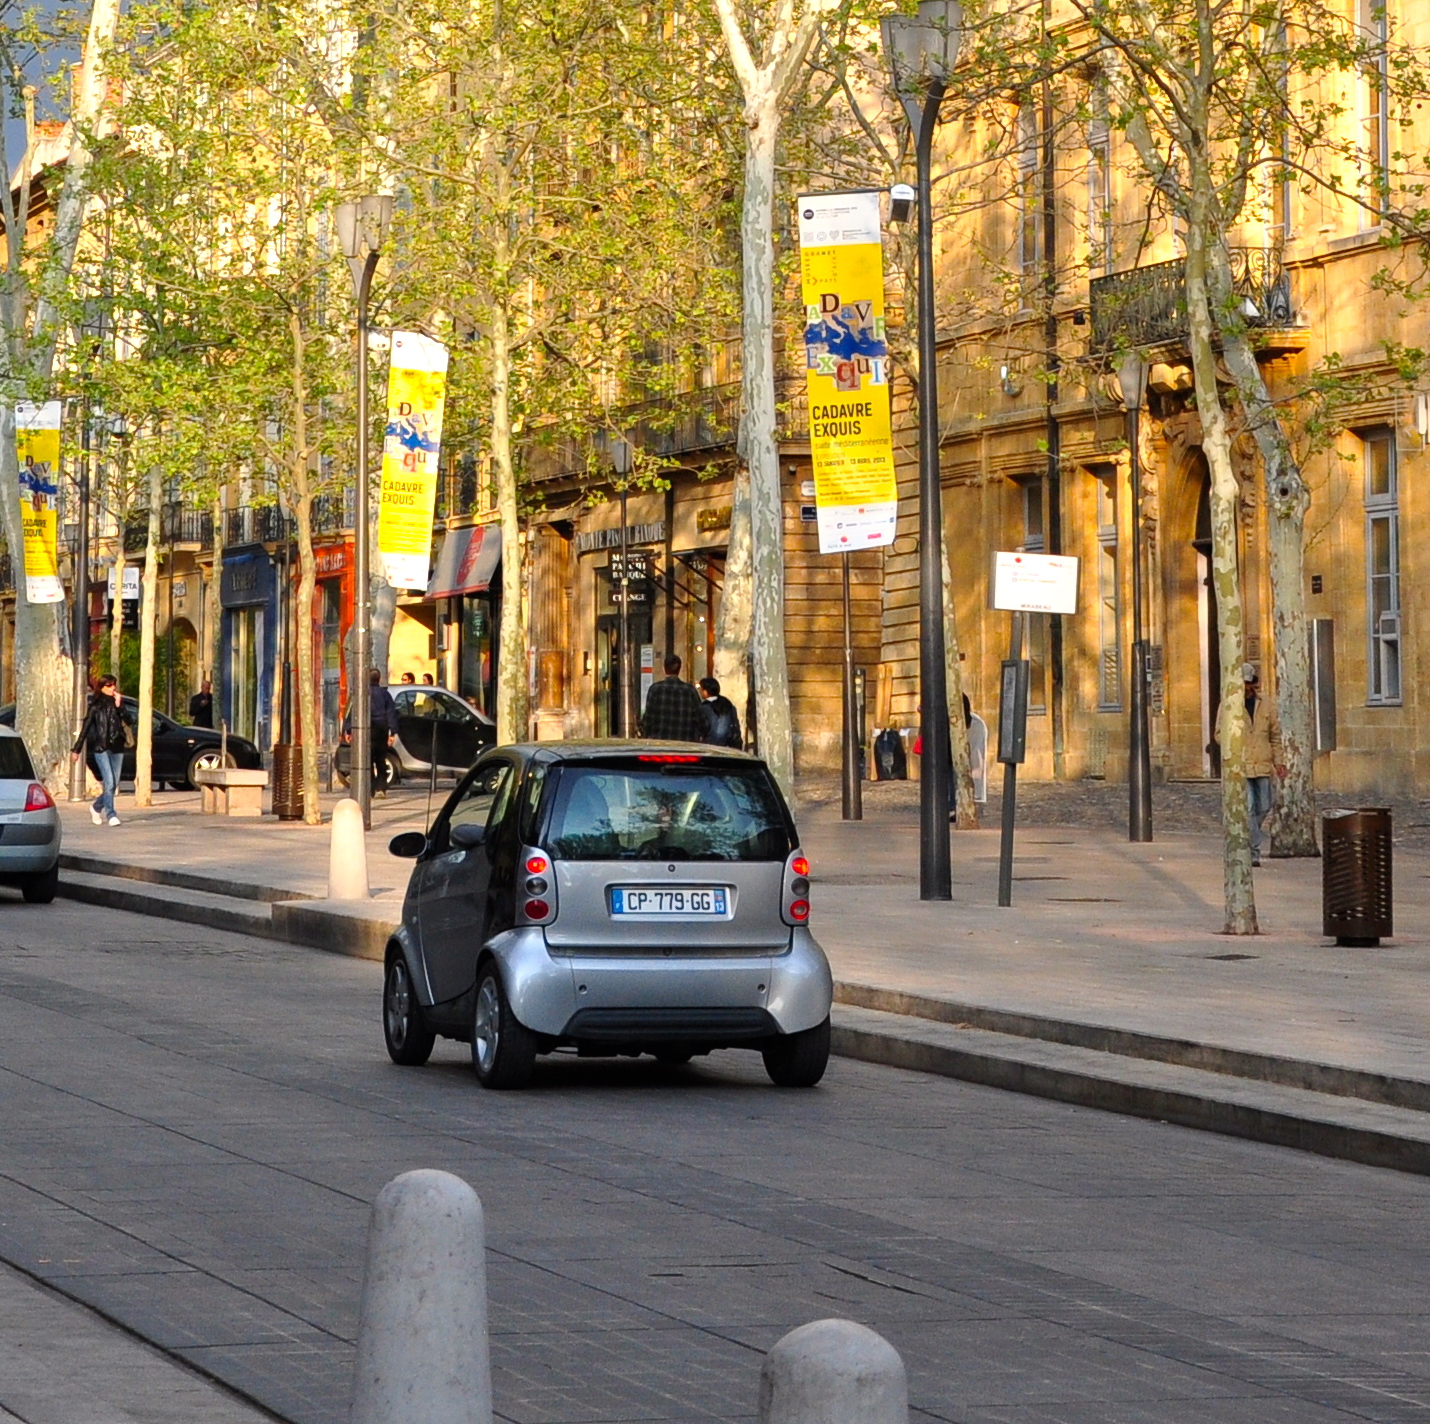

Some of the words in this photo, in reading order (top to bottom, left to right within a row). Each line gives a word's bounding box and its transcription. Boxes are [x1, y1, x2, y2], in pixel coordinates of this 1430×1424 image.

[813, 402, 872, 420] CADAVRE
[814, 420, 861, 438] EXQUIS
[383, 480, 423, 494] CADAVRE
[382, 493, 414, 505] EXQUIS
[628, 893, 710, 910] CP-779-GG
